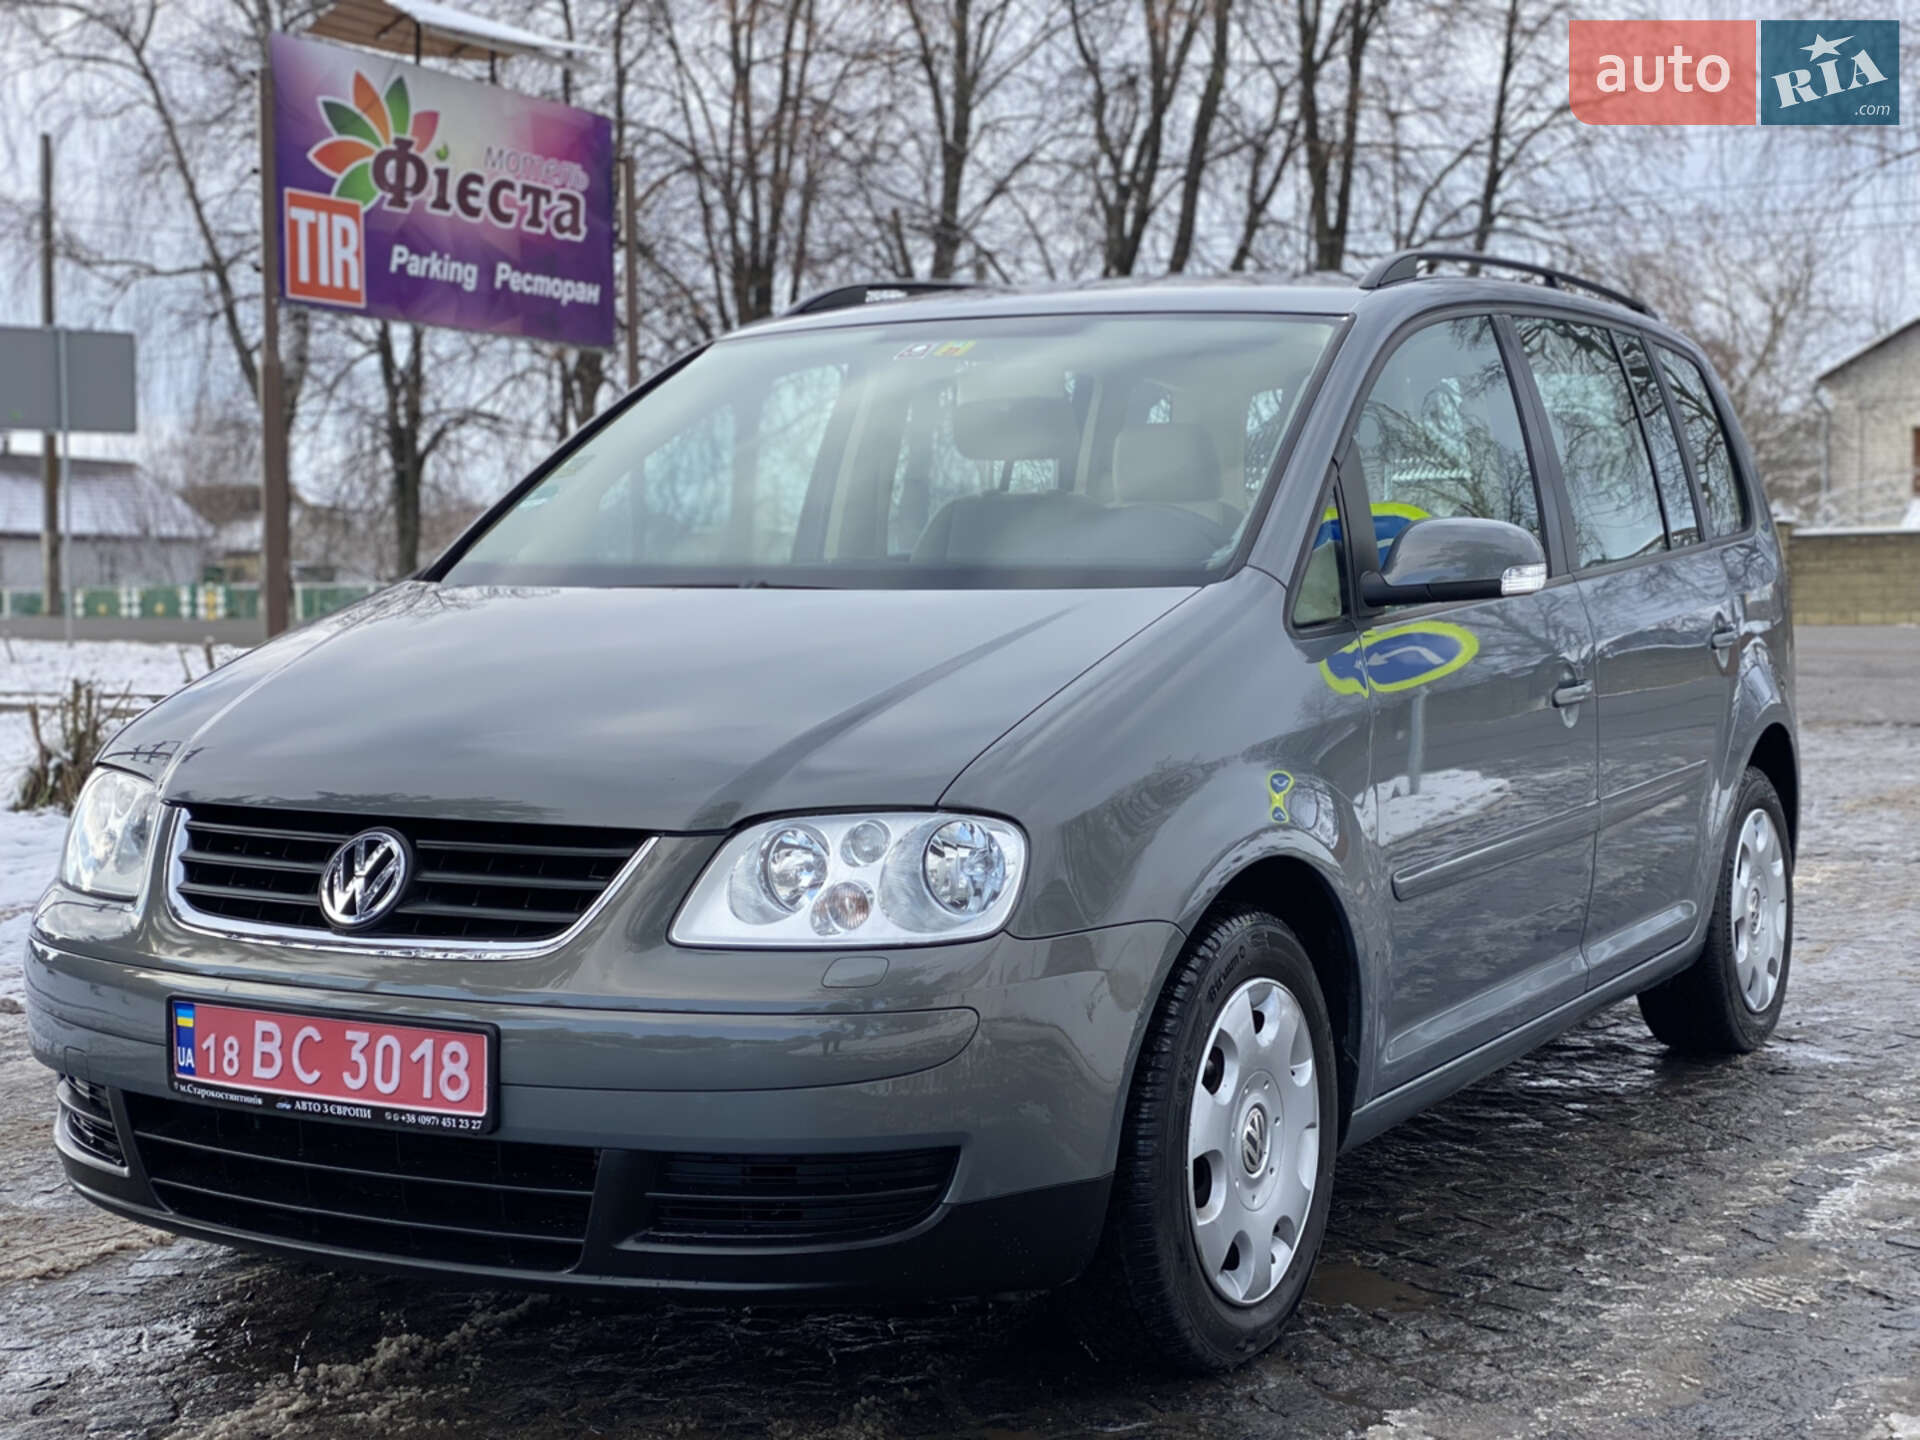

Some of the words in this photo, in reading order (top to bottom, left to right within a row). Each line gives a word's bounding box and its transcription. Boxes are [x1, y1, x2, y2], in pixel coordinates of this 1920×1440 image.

[370, 135, 587, 240] Фієста
[289, 207, 361, 292] TIR
[388, 244, 479, 293] Parking
[494, 262, 601, 306] Ресторан
[177, 1046, 196, 1069] UA
[202, 1033, 240, 1077] 18
[253, 1020, 323, 1086] BC
[342, 1030, 471, 1103] 3018
